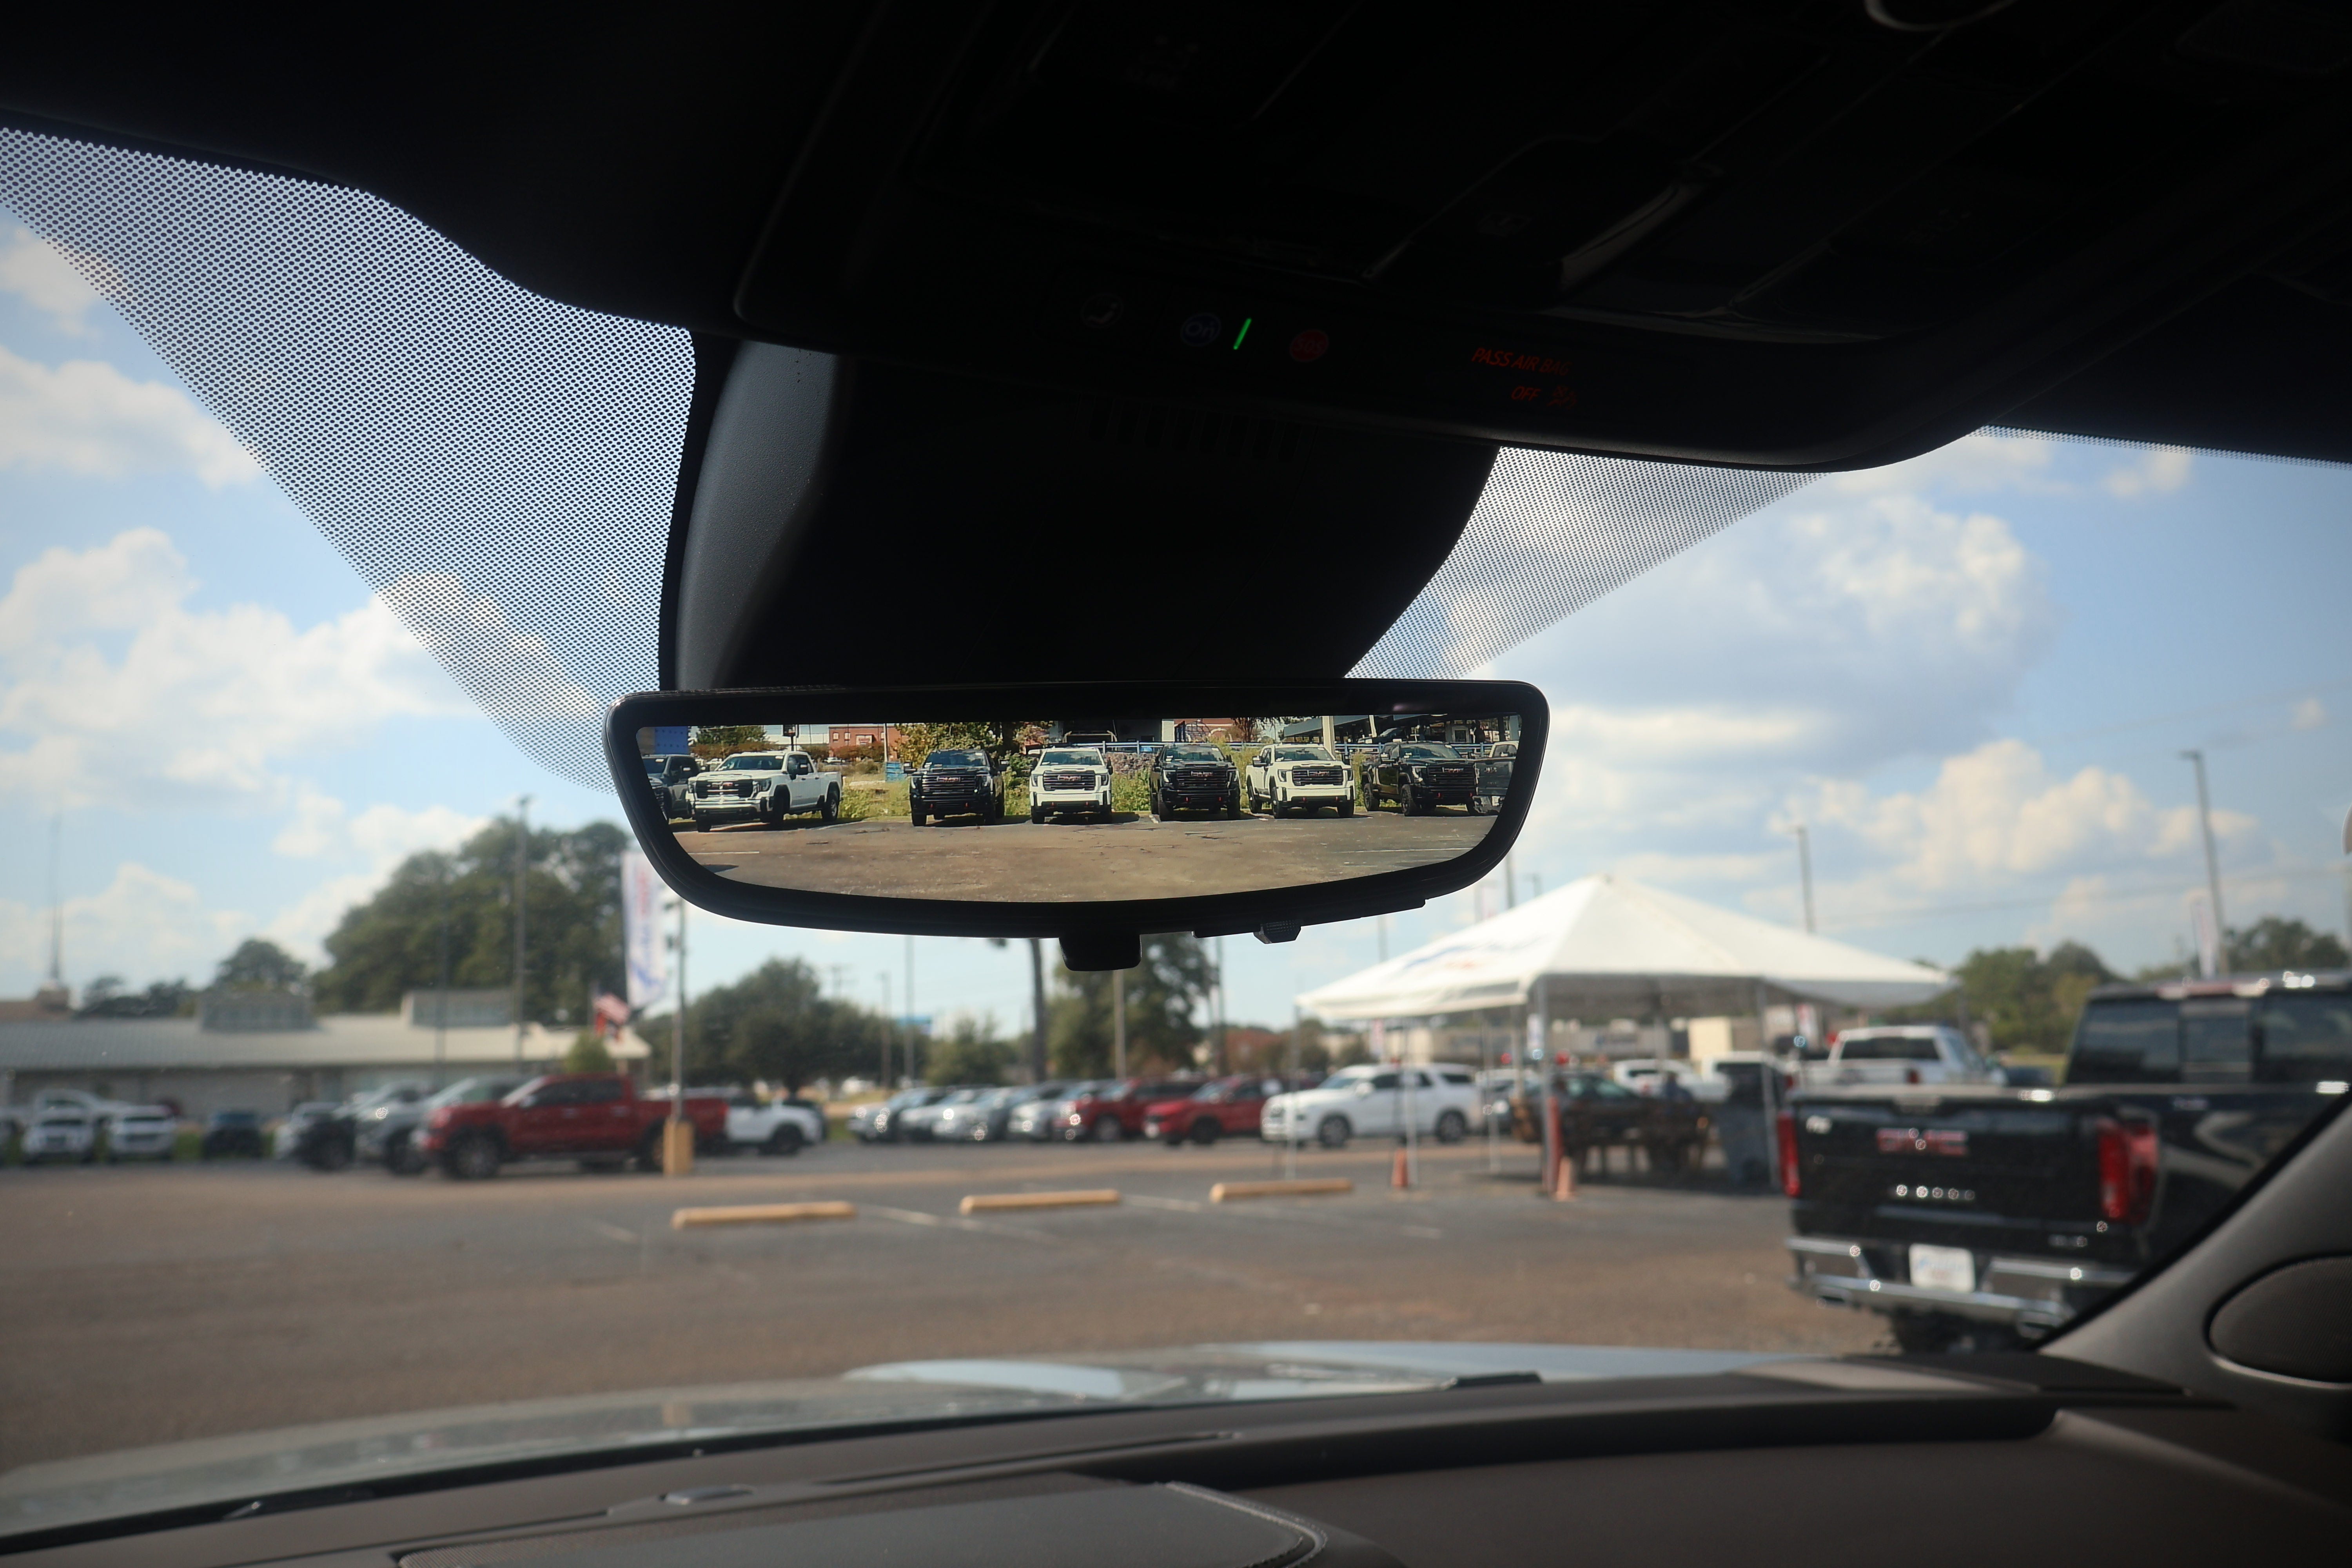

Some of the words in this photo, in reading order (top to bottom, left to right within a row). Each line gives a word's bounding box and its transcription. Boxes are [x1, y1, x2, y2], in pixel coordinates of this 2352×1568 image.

[1292, 337, 1325, 354] SOS
[1470, 346, 1514, 367] PASS
[1510, 354, 1540, 372] AIR
[1538, 358, 1574, 376] BAG
[1510, 385, 1542, 401] OFF
